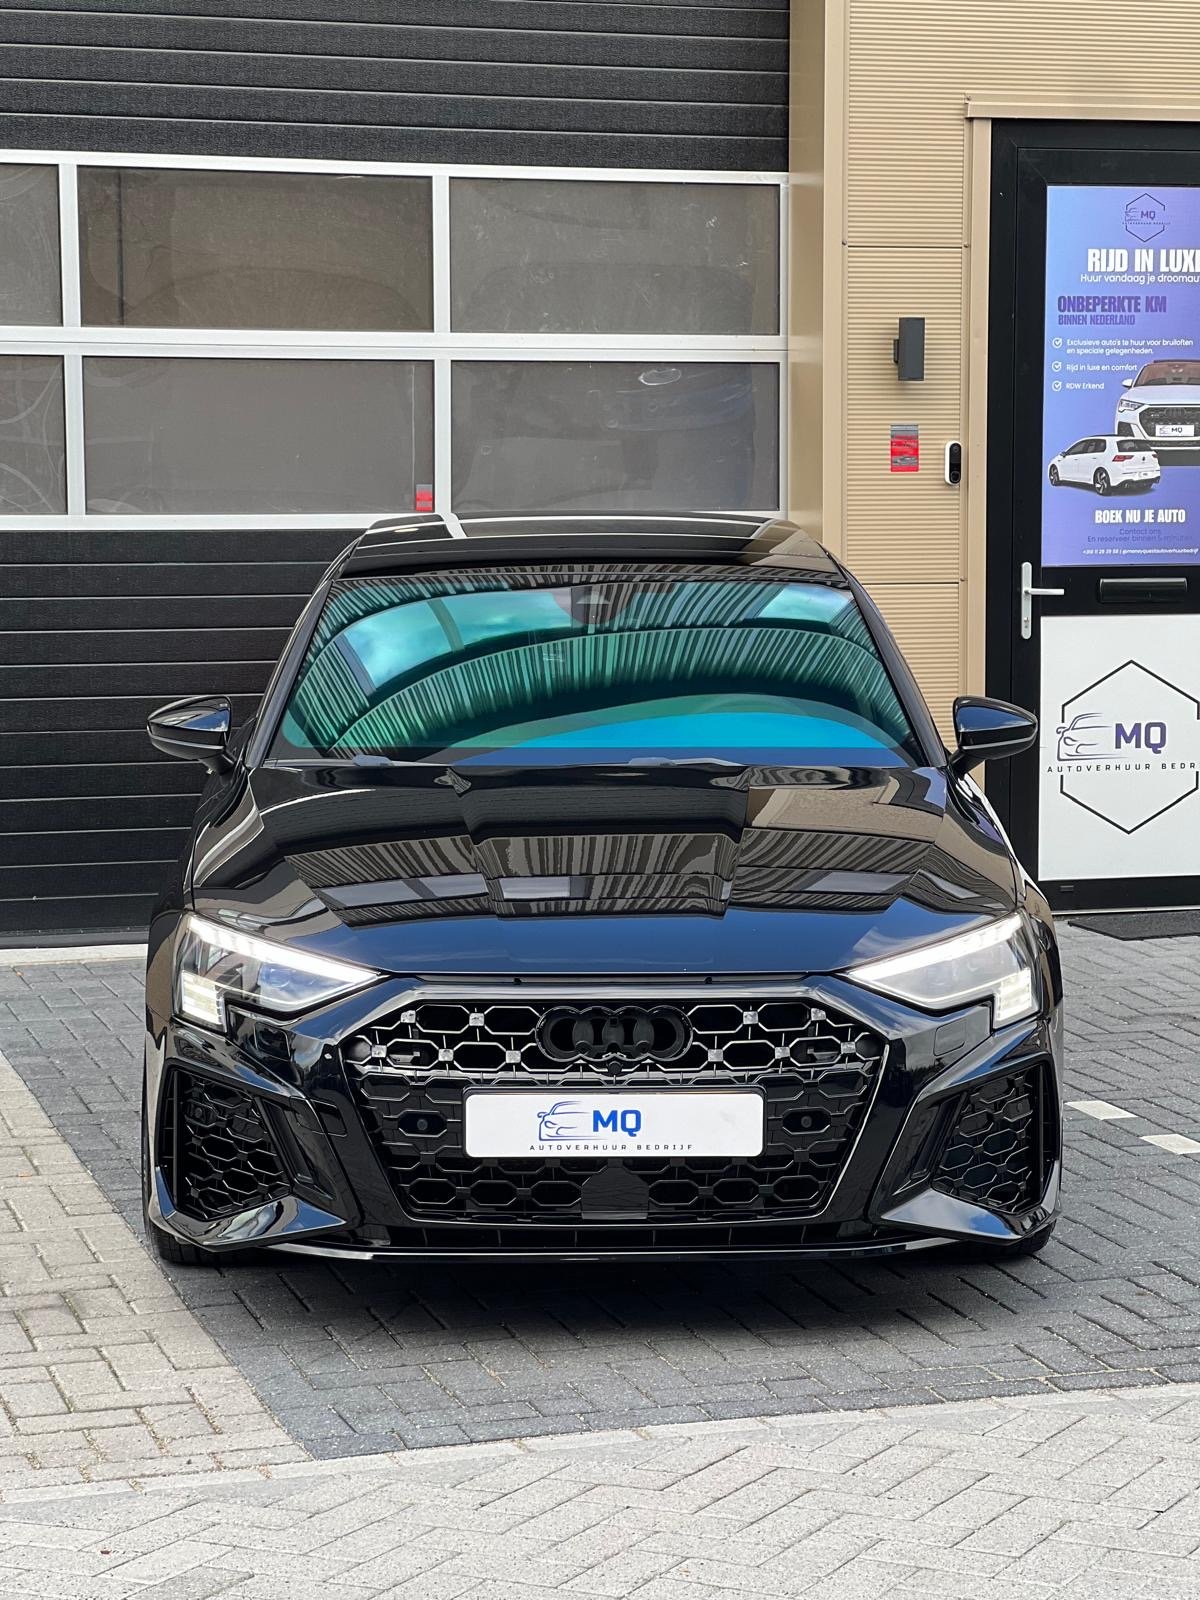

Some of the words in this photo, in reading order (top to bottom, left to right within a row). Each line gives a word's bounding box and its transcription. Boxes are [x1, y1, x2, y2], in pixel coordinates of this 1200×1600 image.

[1140, 210, 1156, 220] MQ
[1087, 248, 1129, 273] RIJD
[1134, 248, 1154, 273] IN
[1080, 273, 1102, 283] Huur
[1104, 273, 1146, 285] vandaag
[1146, 273, 1156, 285] je
[1057, 295, 1141, 313] ONBEPERKTE
[1145, 295, 1167, 313] KM
[1058, 314, 1088, 325] BINNEN
[1089, 314, 1136, 325] NEDERLAND
[1066, 338, 1100, 346] Exclusieve
[1101, 338, 1121, 346] auto's
[1122, 338, 1129, 346] te
[1130, 338, 1146, 346] huur
[1147, 338, 1161, 346] voor
[1162, 338, 1194, 346] bruiloften
[1076, 347, 1104, 356] speciale
[1094, 509, 1123, 524] BOEK
[1125, 509, 1141, 523] NU
[1143, 509, 1155, 523] JE
[1157, 509, 1186, 523] AUTO
[1119, 528, 1148, 536] Contact
[1114, 721, 1168, 755] MQ
[1046, 763, 1152, 773] AUTOVERHUUR
[592, 1109, 643, 1138] MQ
[529, 1143, 628, 1151] AUTOVERHUUR
[636, 1143, 694, 1151] BEDRIJF
